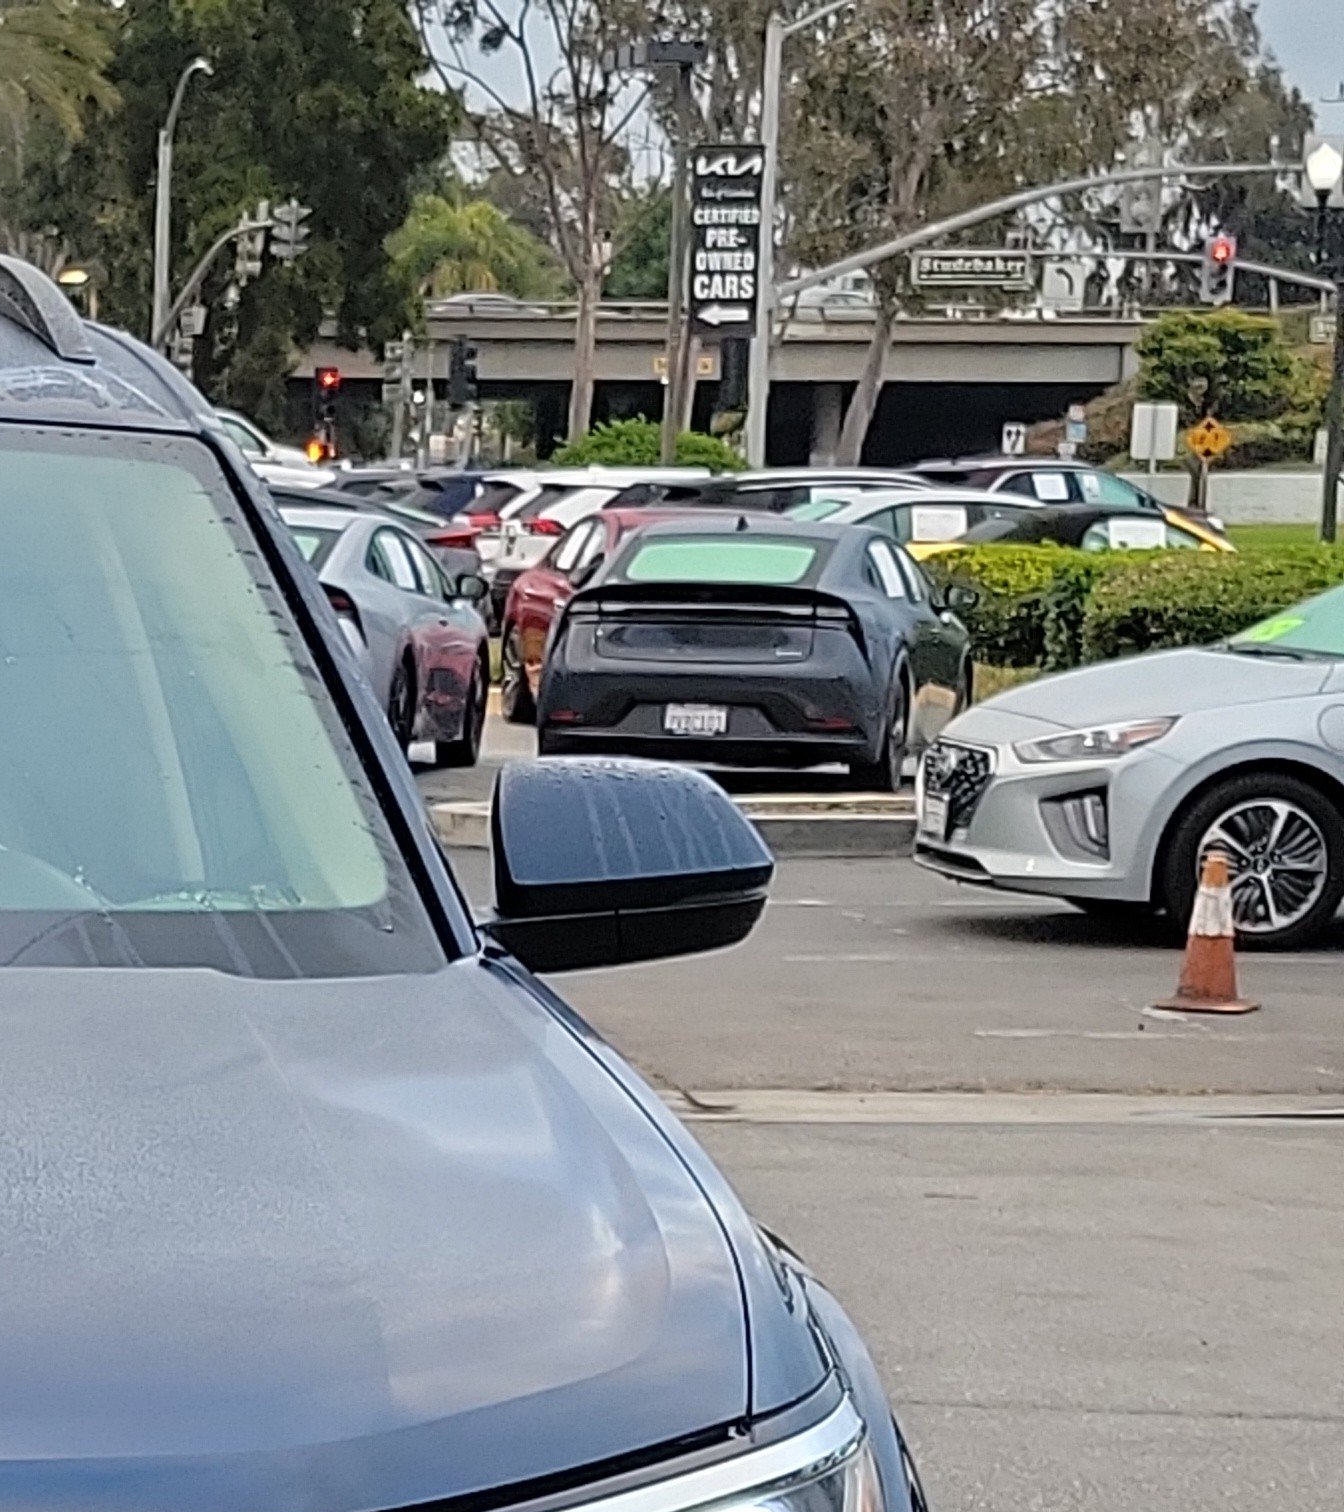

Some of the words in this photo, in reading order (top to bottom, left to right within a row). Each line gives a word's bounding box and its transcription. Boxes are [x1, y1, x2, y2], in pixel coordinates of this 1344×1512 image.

[693, 207, 760, 226] CERTIFIED
[705, 227, 748, 249] PRE-
[695, 251, 755, 272] OWNED
[693, 273, 755, 300] CARS
